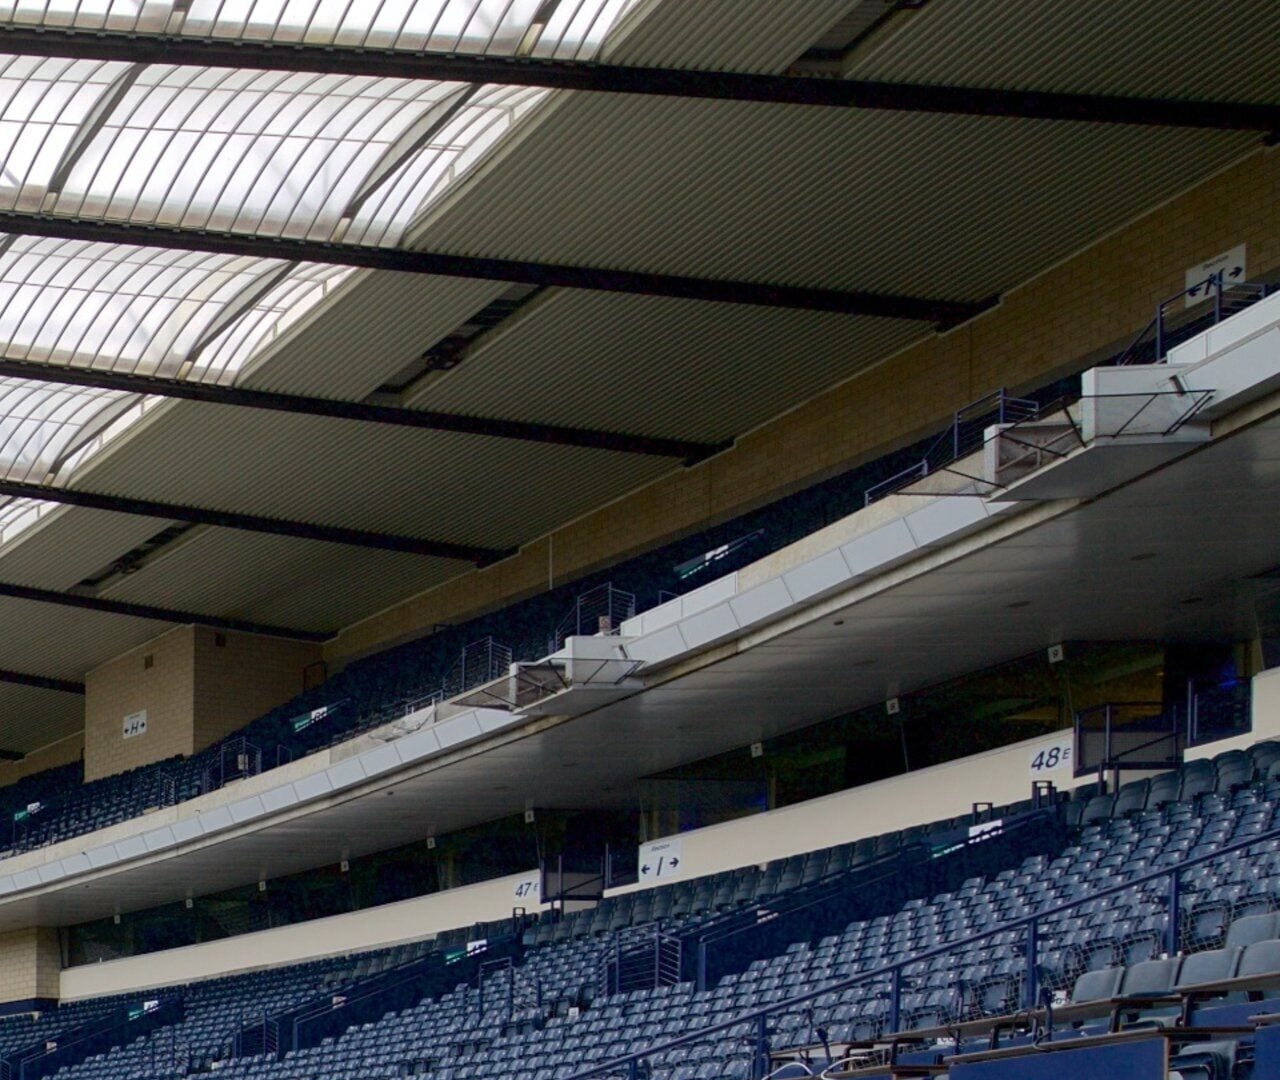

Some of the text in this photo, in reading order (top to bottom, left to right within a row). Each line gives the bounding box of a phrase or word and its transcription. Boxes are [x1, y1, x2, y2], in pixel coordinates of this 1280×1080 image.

[130, 720, 139, 735] H
[1031, 747, 1071, 771] 48 E
[515, 882, 532, 897] 47
